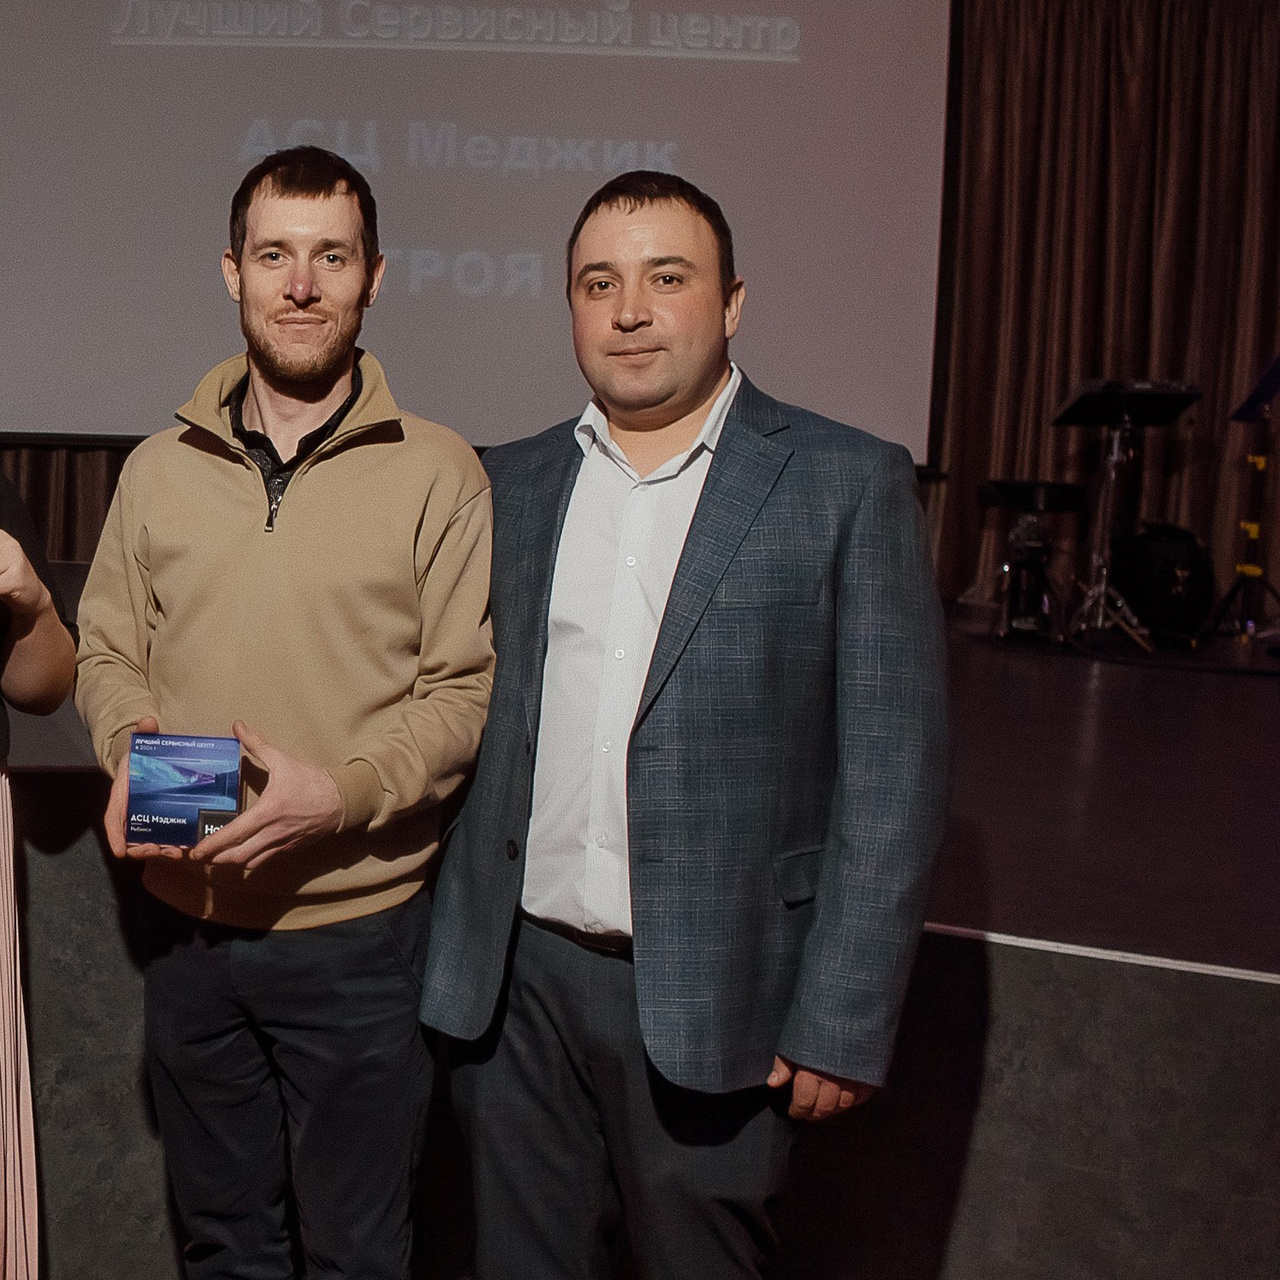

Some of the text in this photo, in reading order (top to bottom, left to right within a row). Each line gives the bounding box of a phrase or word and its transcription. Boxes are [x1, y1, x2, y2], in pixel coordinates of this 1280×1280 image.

[648, 12, 800, 54] центр
[407, 121, 678, 178] Меджик
[135, 738, 215, 749] ЛУЧШИЙ СЕРВИСНЫЙ ЦЕНТР
[130, 814, 187, 825] АСЦ Мэджик
